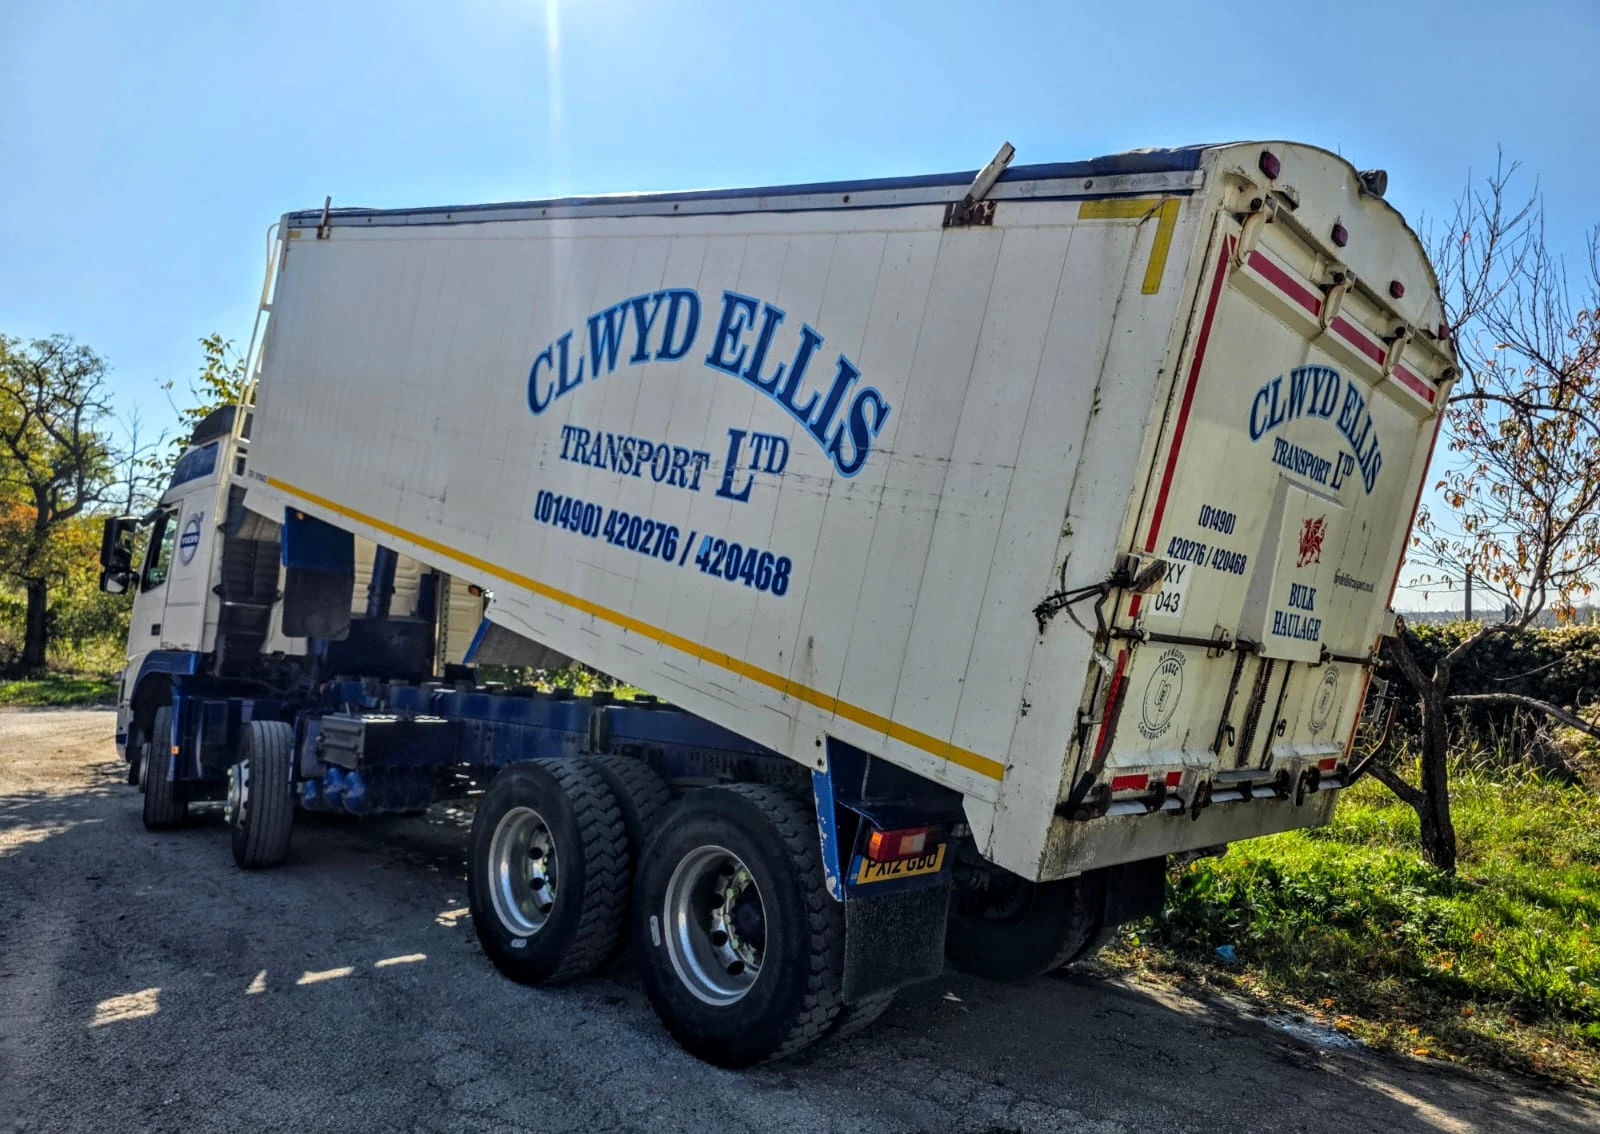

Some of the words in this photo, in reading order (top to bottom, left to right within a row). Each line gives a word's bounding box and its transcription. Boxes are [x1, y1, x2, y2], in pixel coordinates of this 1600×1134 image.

[527, 287, 701, 416] CLWYD
[704, 289, 892, 478] ELLIS
[1248, 364, 1341, 442] CLWYD
[1336, 379, 1383, 496] ELLIS
[559, 424, 710, 491] TRANSPORT
[715, 428, 790, 503] LTD
[1272, 436, 1332, 485] TRANSPORT
[1330, 450, 1355, 490] LTD
[1198, 504, 1237, 535] (01490)
[534, 490, 603, 538] (01490)
[602, 509, 679, 562] 420276
[678, 531, 696, 567] /
[695, 534, 792, 596] 420468
[1167, 536, 1207, 566] 420276
[1211, 548, 1247, 576] 420468
[1164, 562, 1187, 584] XY
[1155, 591, 1181, 613] 043
[1288, 582, 1317, 611] BULK
[1272, 610, 1321, 641] HAULAGE
